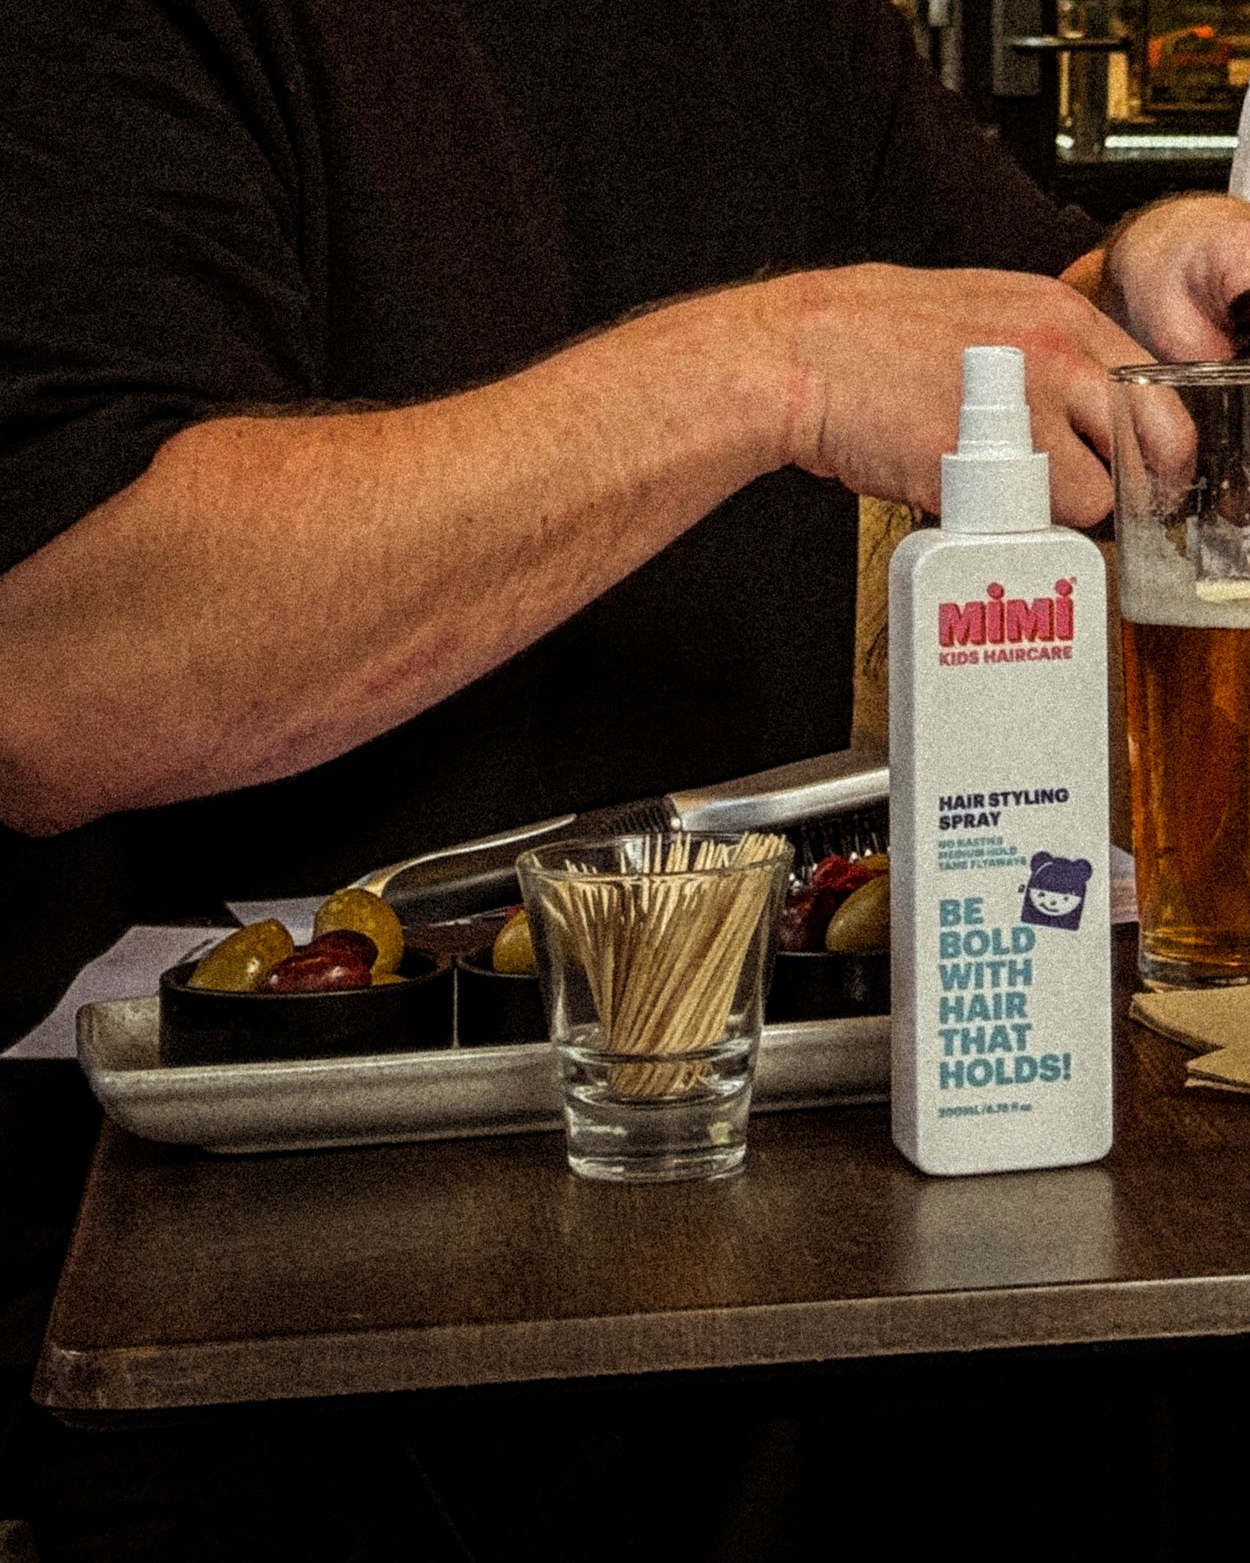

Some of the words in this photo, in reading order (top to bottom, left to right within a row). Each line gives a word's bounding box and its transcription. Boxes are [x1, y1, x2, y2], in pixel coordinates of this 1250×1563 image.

[939, 651, 979, 666] KIDS
[984, 645, 1072, 663] HAIRCARE
[939, 794, 985, 811] HAIR
[988, 788, 1069, 807] STYLING
[939, 811, 1002, 830] SPRAY
[939, 897, 984, 927] BE
[939, 927, 1036, 959] BOLD
[938, 959, 1033, 991] WITH
[938, 992, 1028, 1024] HAIR
[938, 1023, 1033, 1056] THAT
[938, 1053, 1072, 1089] HOLDS!
